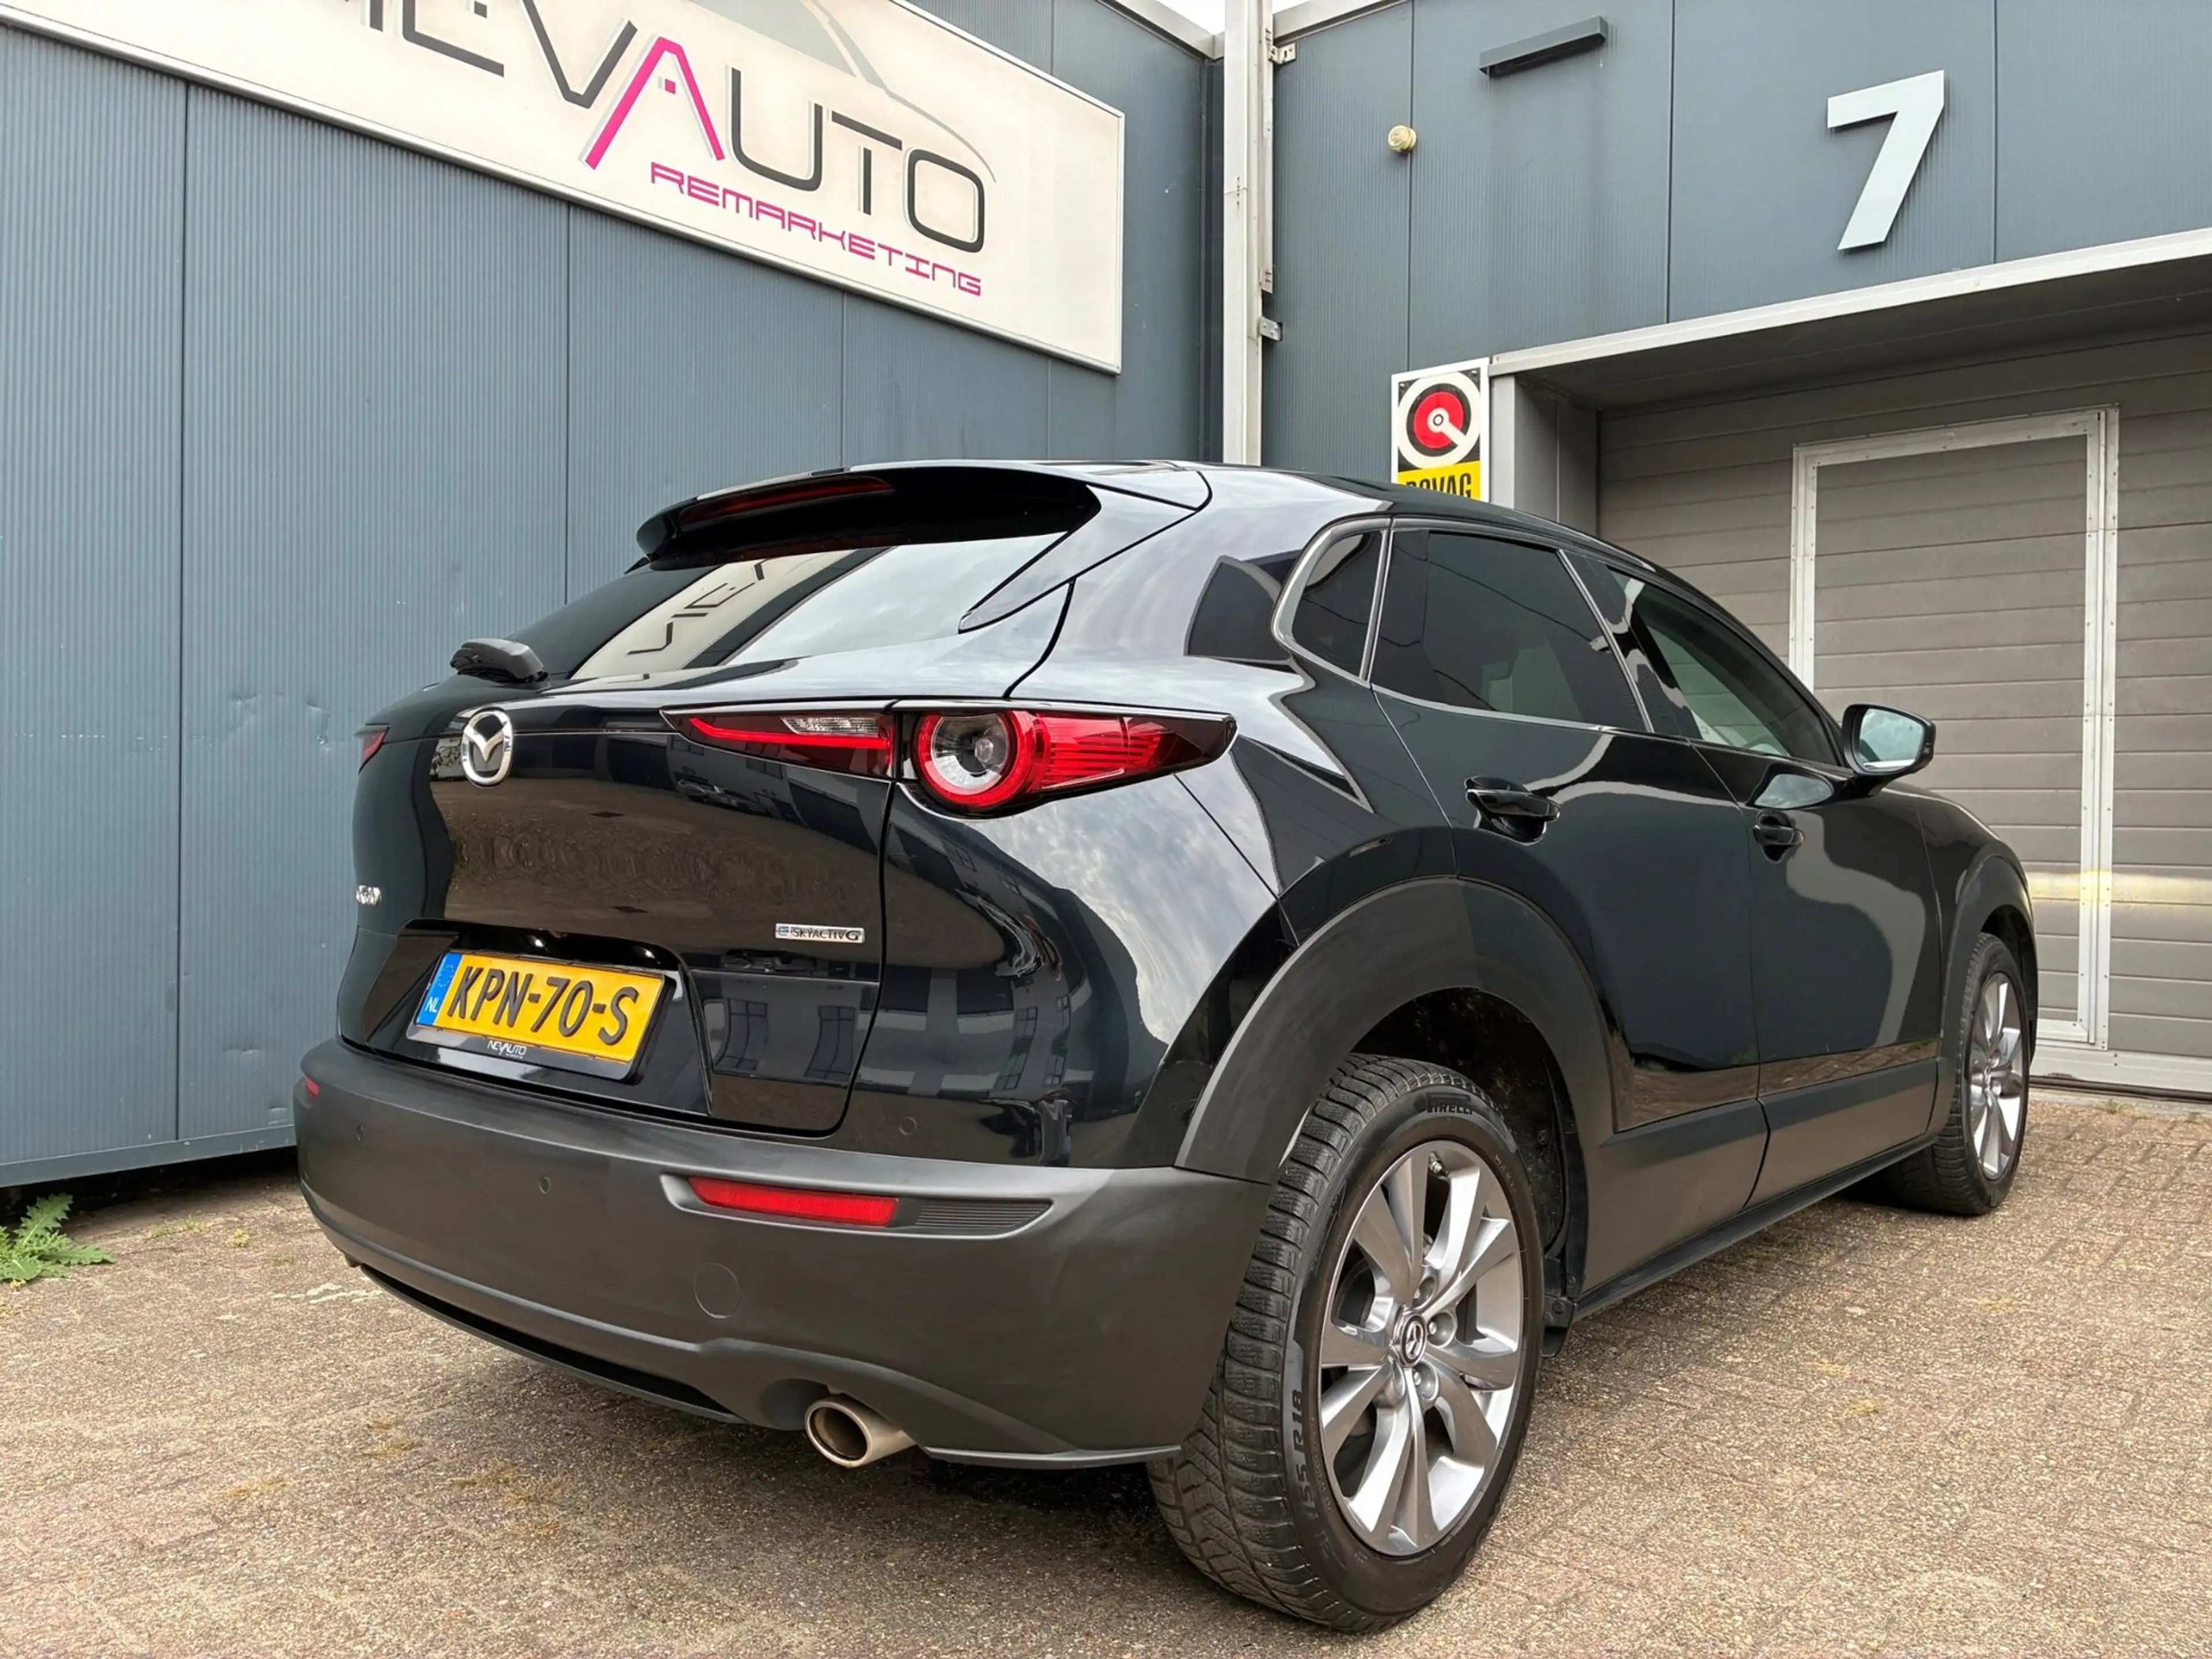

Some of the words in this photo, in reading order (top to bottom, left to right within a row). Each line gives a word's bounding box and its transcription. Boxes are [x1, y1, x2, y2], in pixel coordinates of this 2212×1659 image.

[1827, 70, 1944, 250] 7
[651, 162, 982, 297] REMARKETING
[424, 996, 439, 1013] NL
[446, 966, 639, 1046] KPN-70-S
